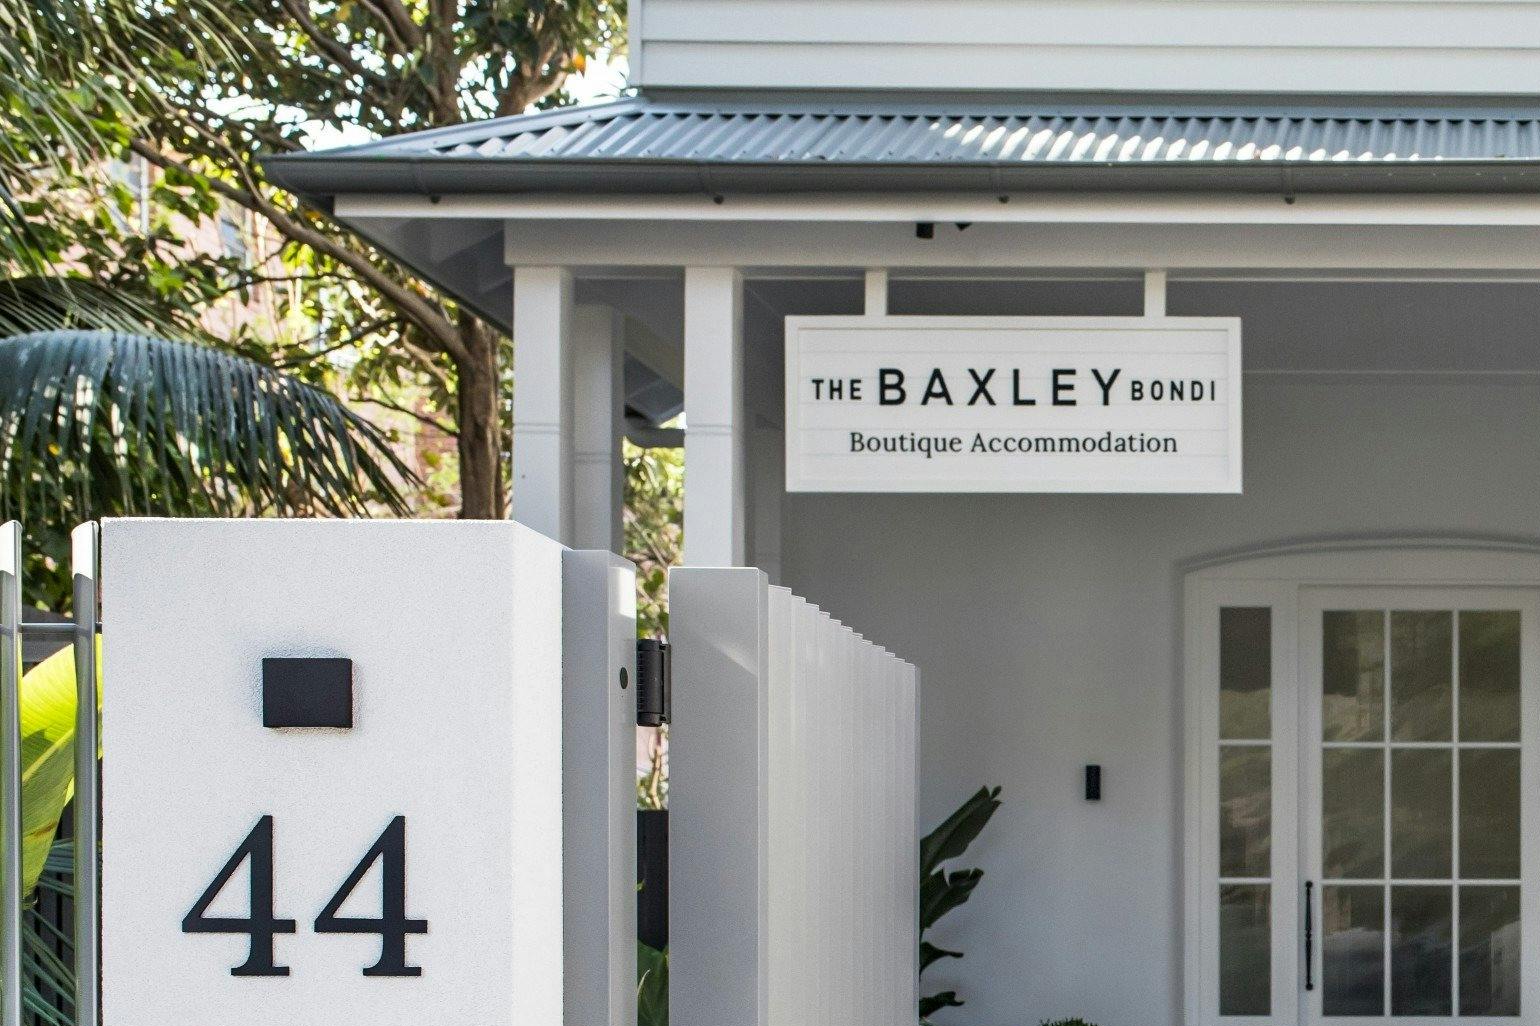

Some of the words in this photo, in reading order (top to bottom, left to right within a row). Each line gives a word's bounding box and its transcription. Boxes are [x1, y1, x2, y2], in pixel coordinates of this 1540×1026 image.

[812, 378, 863, 401] THE
[878, 368, 1122, 407] BAXLEY
[1130, 380, 1216, 402] BONDI
[849, 432, 962, 458] Boutique
[970, 431, 1178, 454] Accommodation
[182, 814, 428, 977] 44
